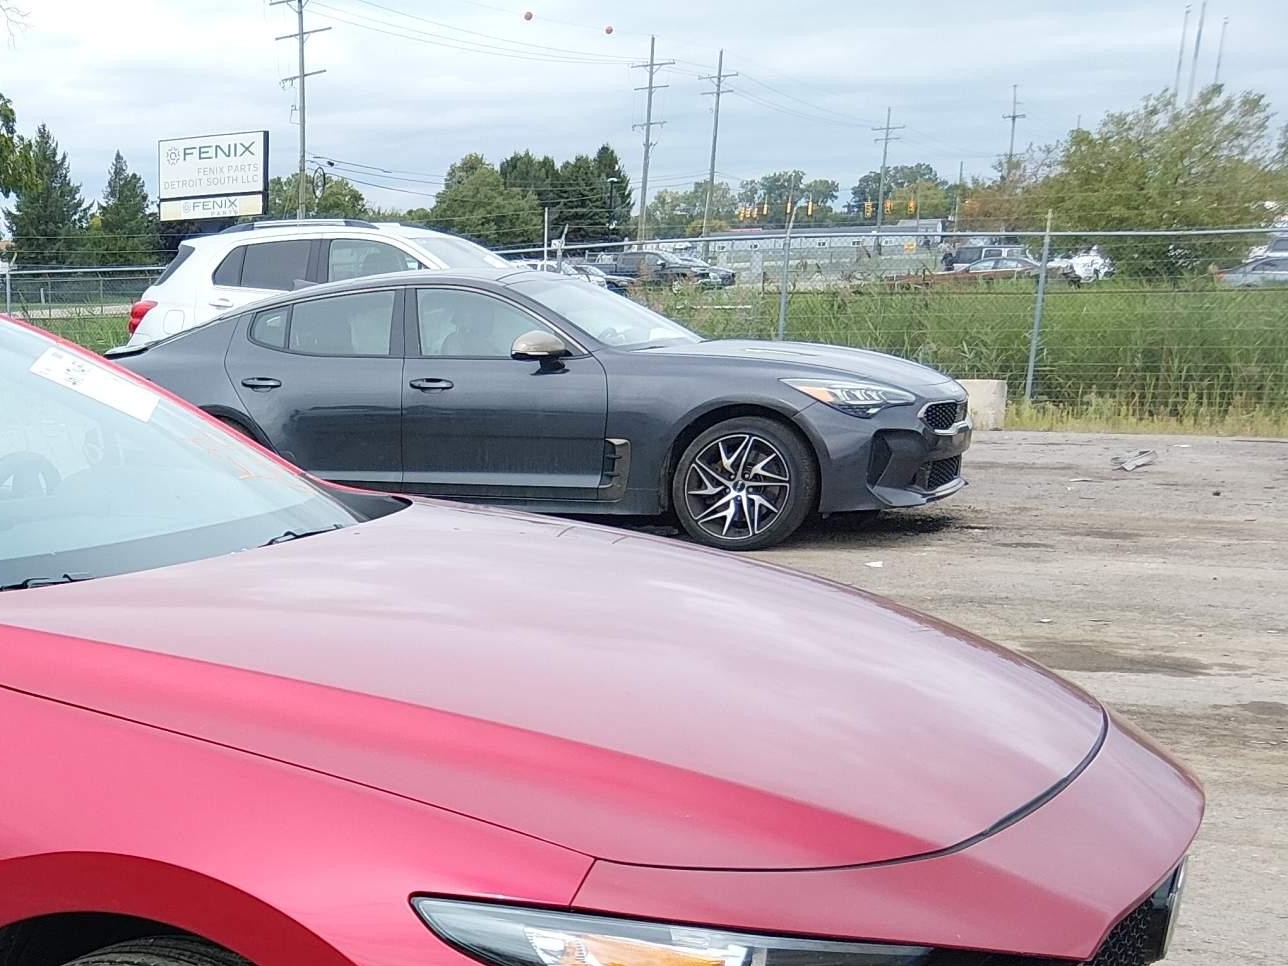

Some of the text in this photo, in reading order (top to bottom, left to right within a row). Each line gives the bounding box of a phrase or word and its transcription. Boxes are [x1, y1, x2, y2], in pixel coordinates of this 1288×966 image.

[183, 141, 255, 161] FENIX
[197, 163, 259, 177] FENIX PARTS
[164, 174, 259, 190] DETROIT SOUTH LLC
[193, 198, 238, 211] FENIX
